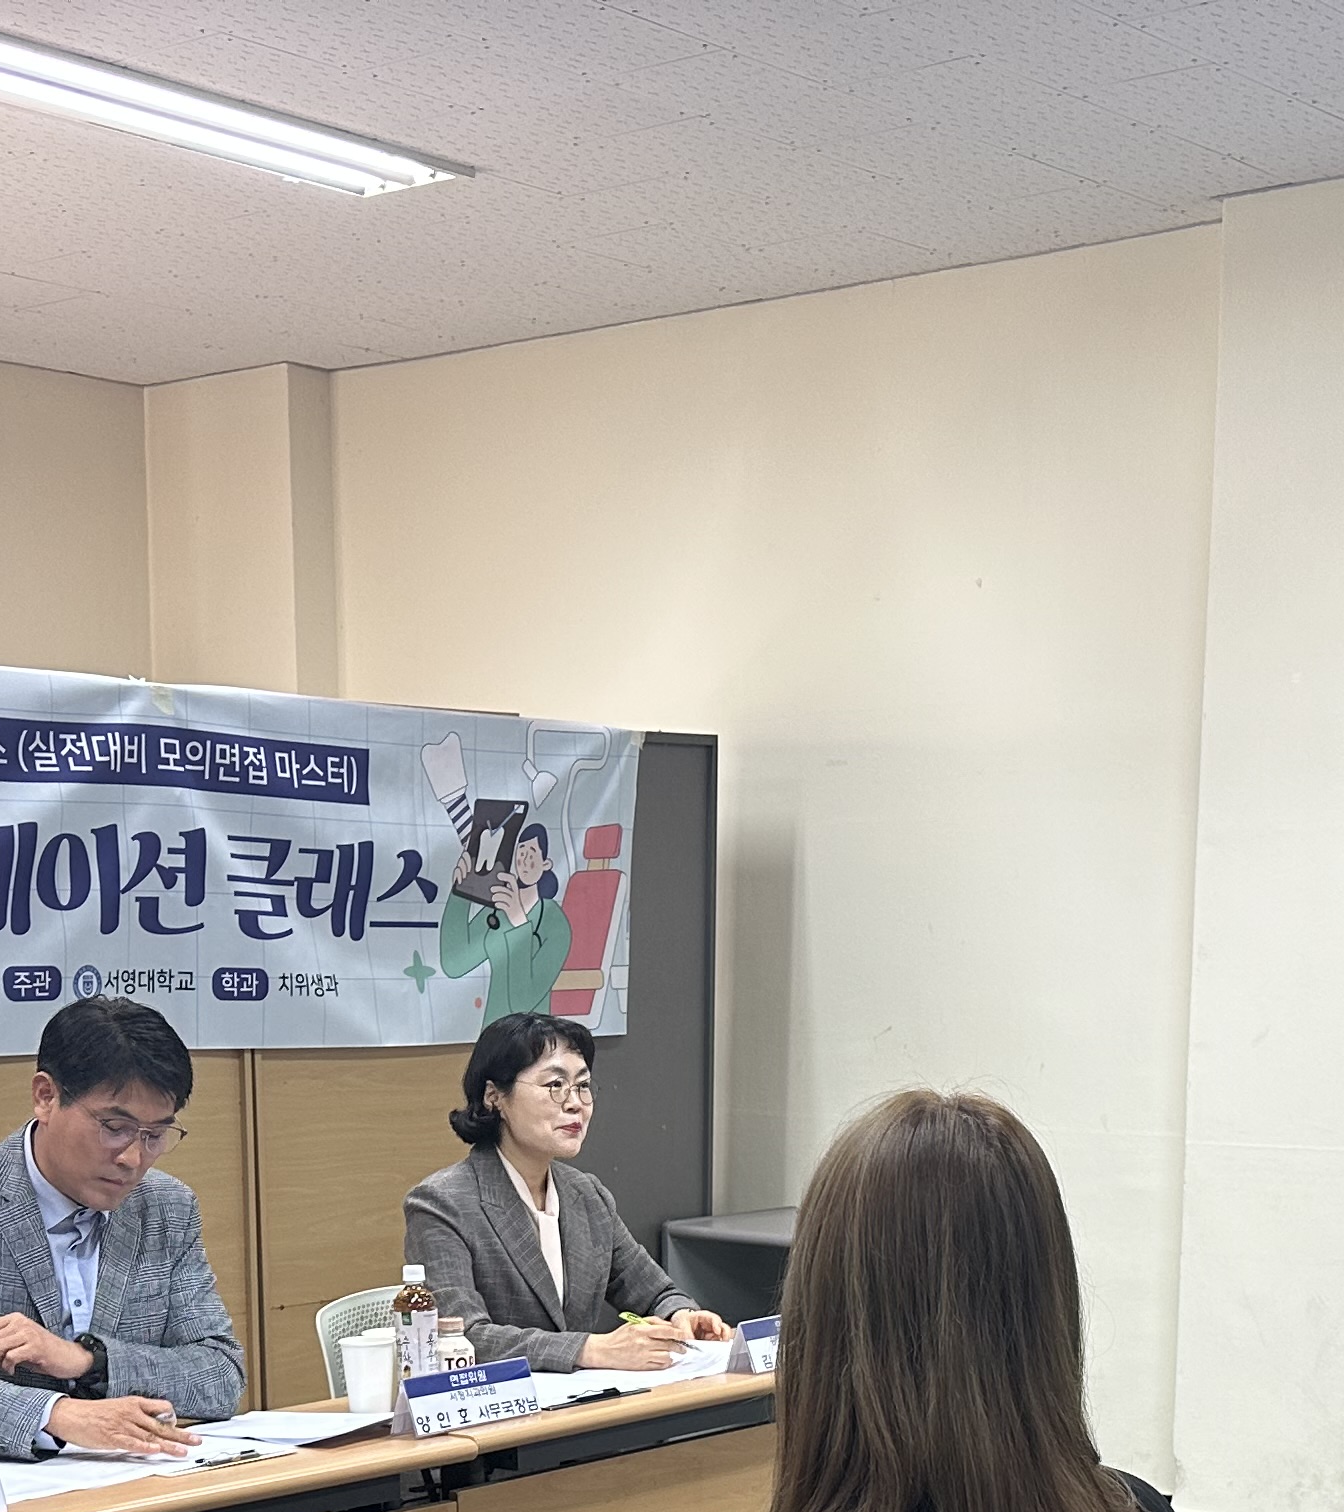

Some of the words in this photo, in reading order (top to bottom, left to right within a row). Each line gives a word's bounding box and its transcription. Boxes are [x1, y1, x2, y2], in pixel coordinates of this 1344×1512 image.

[17, 729, 148, 774] (실전대비
[157, 736, 268, 786] 모의면접
[274, 749, 358, 795] 마스터)
[225, 832, 441, 943] 클래스
[12, 970, 52, 998] 주관
[104, 968, 196, 995] 서영대학교
[221, 971, 259, 998] 학과
[278, 972, 340, 998] 치위생과
[449, 1369, 488, 1388] 면접위원
[478, 1396, 539, 1420] 사무국장님
